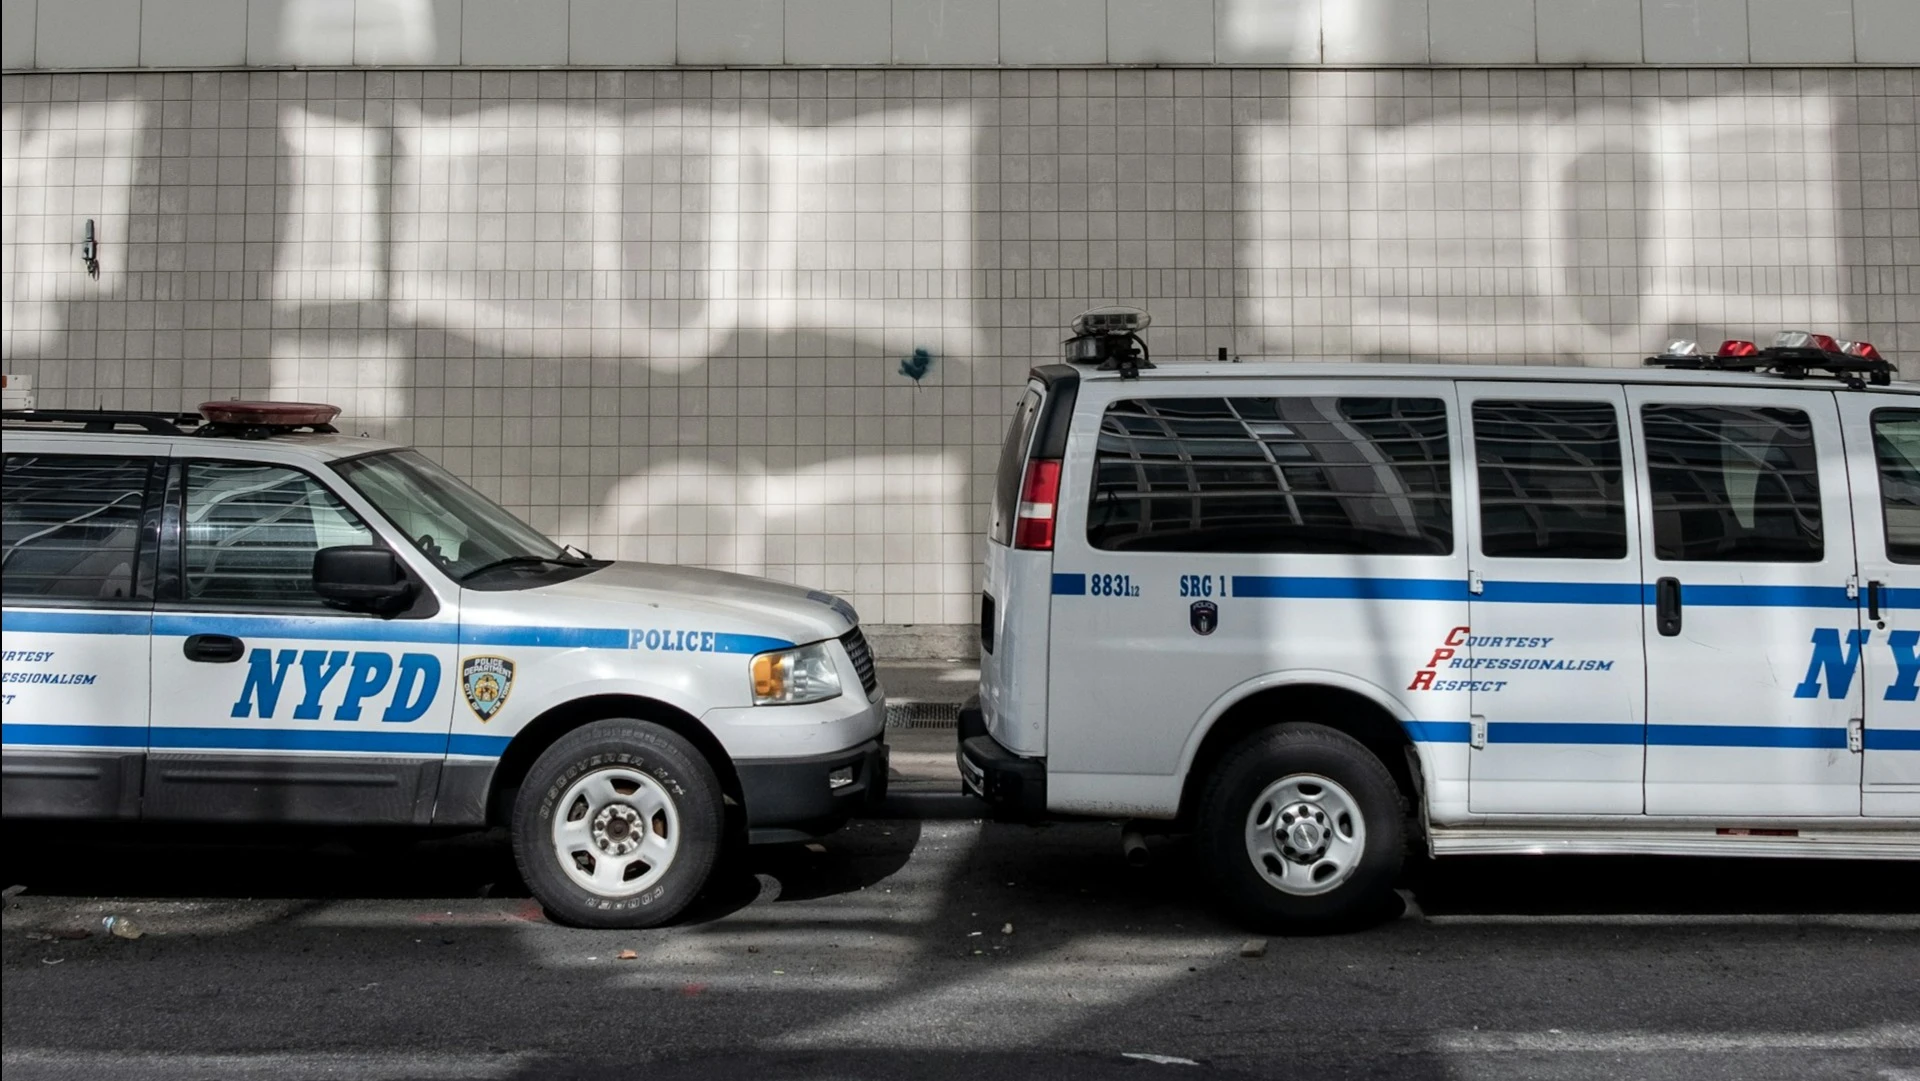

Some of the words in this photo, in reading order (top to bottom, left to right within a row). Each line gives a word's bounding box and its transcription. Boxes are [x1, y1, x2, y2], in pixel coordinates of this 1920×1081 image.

[1091, 573, 1130, 597] 8831
[1180, 574, 1212, 597] SRG
[1219, 575, 1226, 597] 1
[630, 629, 714, 652] POLICE
[1444, 626, 1554, 648] COURTESY
[464, 665, 512, 677] DEPARTMENT
[474, 658, 503, 666] POLICE
[1426, 648, 1614, 671] PROFESSIONALISM
[230, 648, 442, 722] NYPD
[1407, 671, 1507, 692] RESPECT
[464, 683, 474, 699] CITY
[471, 701, 480, 710] OF
[585, 885, 664, 910] COOPER
